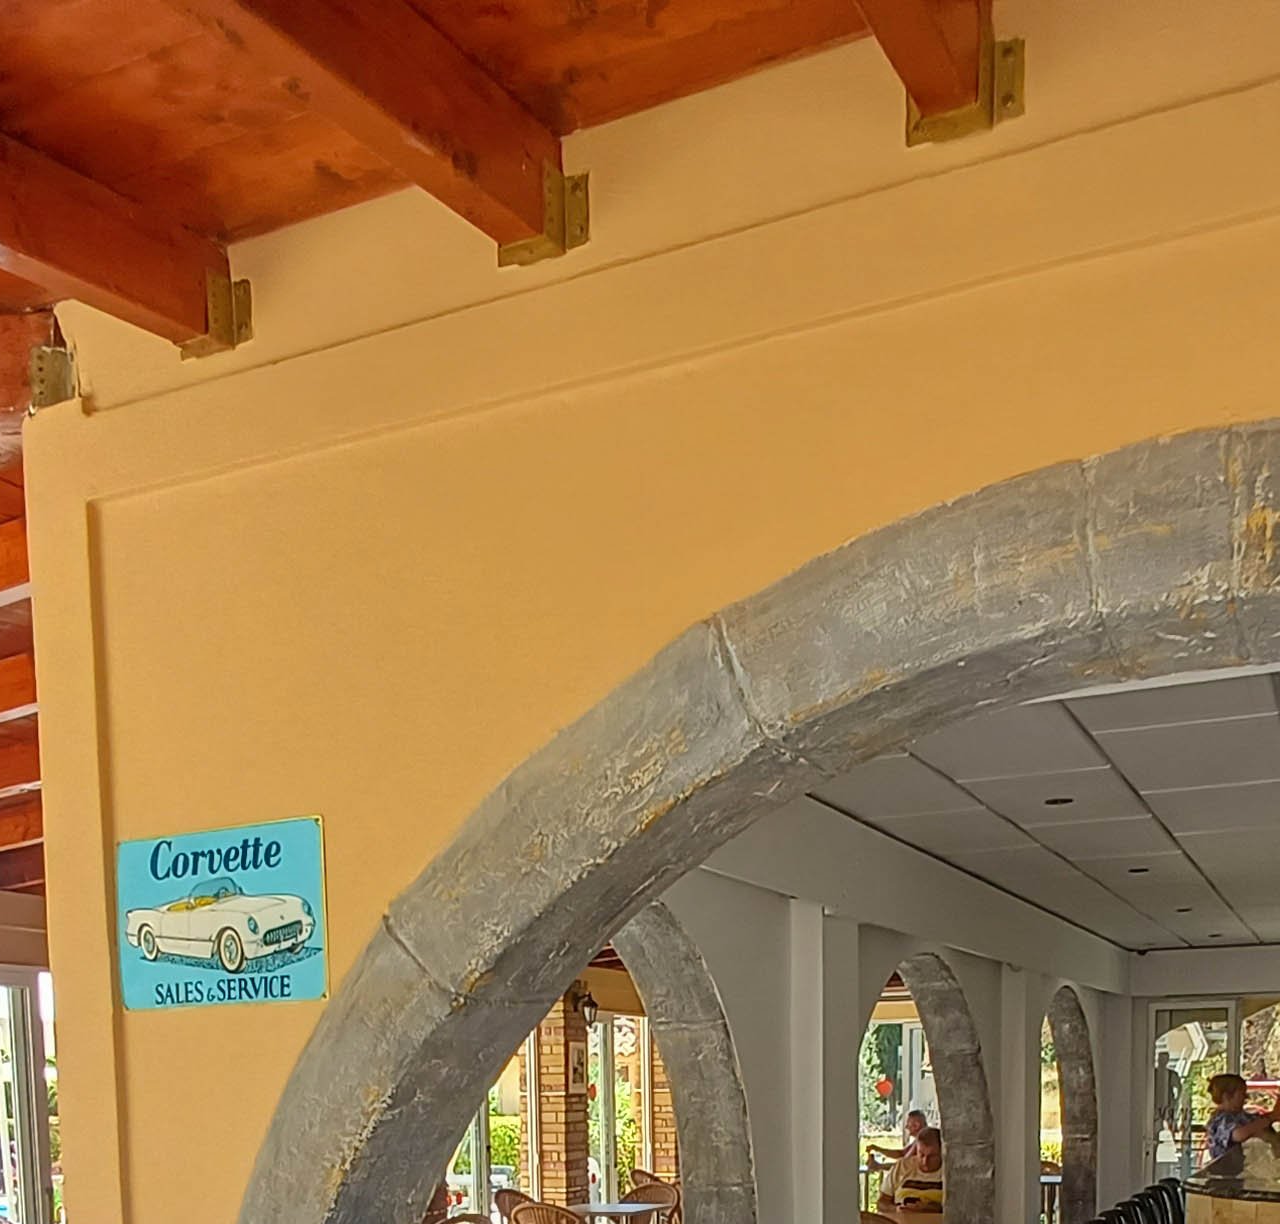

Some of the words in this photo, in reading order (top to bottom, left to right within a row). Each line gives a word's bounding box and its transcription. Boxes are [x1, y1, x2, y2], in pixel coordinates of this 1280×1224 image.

[150, 837, 282, 880] Corvette
[155, 980, 204, 1005] SALES
[217, 975, 291, 1001] SERVICE
